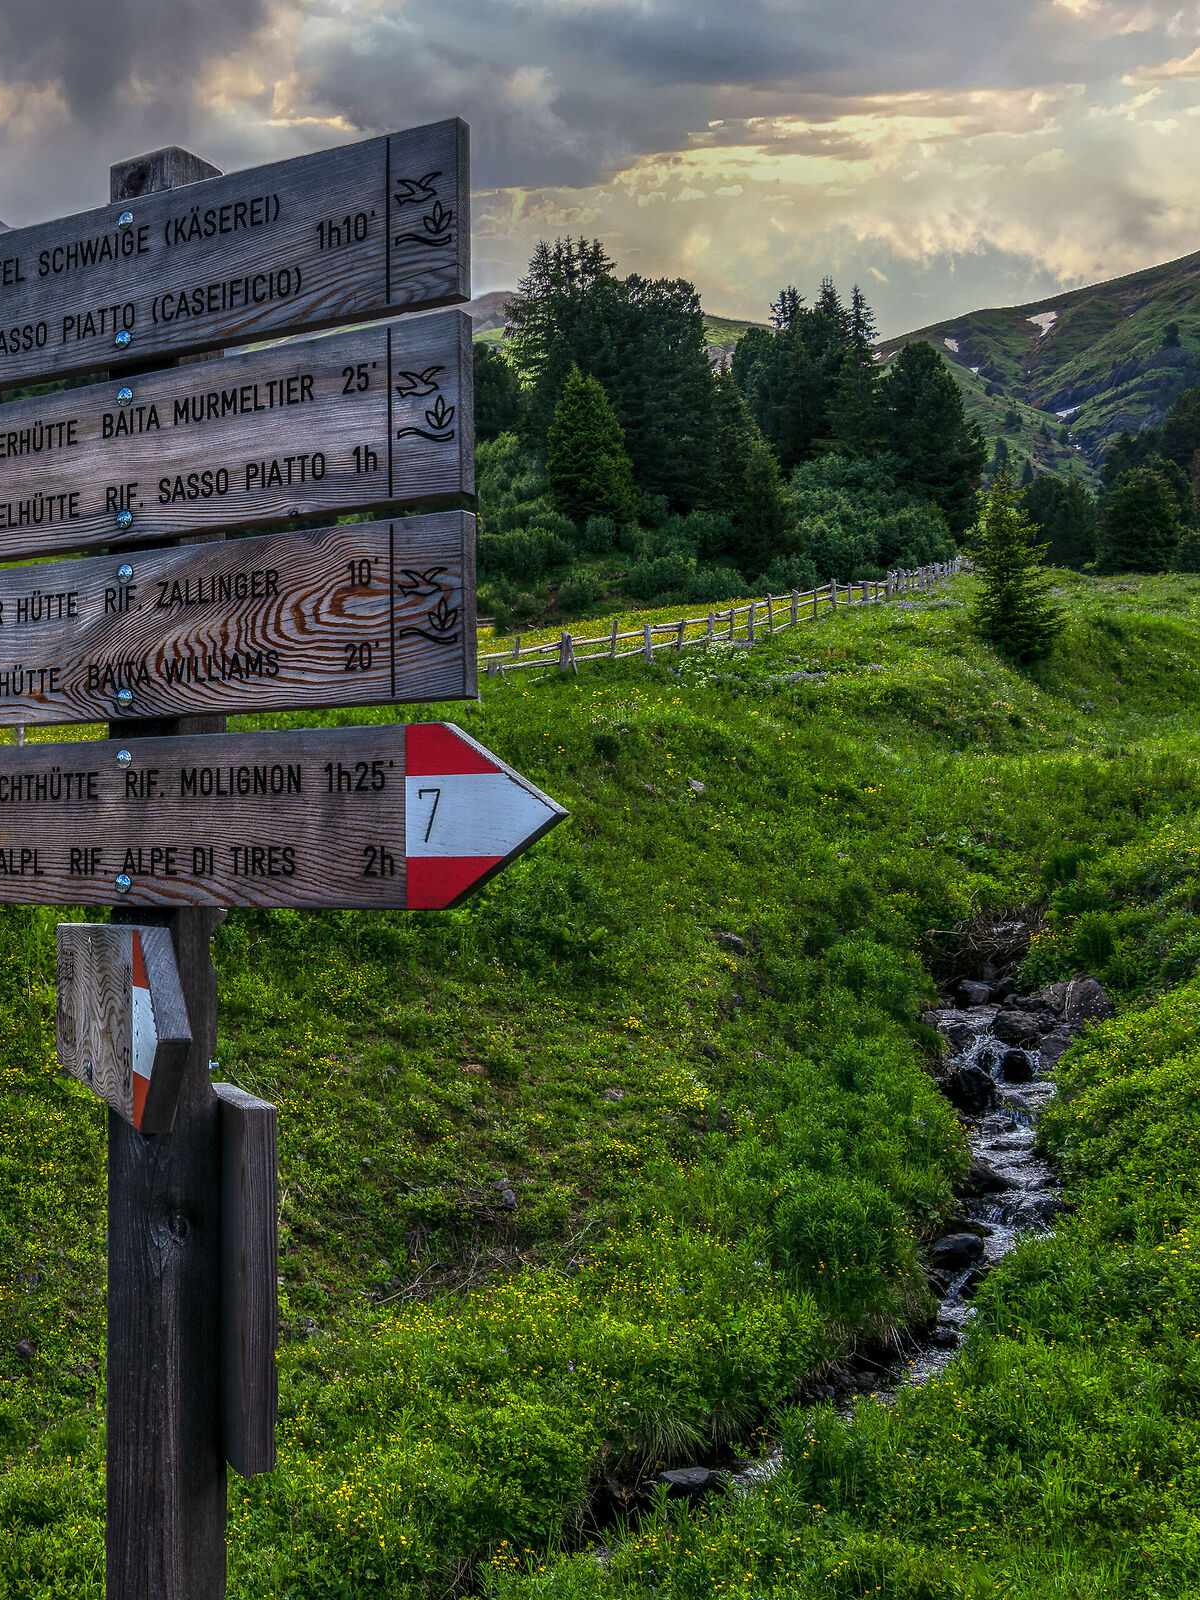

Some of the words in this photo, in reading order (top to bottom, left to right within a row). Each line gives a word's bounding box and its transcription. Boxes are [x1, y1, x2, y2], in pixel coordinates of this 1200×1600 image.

[38, 225, 150, 276] SCHWAIGE
[164, 194, 281, 247] (KÄSEREI)
[62, 303, 135, 343] PIATTO
[152, 267, 301, 324] (CASEIFICIO)
[102, 404, 160, 439] BAITA
[173, 374, 314, 426] MURMELTIER
[105, 483, 143, 513] RIF.
[158, 468, 229, 504] SASSO
[246, 453, 325, 491] PIATTO
[352, 445, 378, 474] 1h
[17, 590, 78, 623] HÜTTE
[104, 585, 142, 614] RIF.
[157, 569, 280, 609] ZALLINGER
[88, 661, 150, 691] BAITA
[164, 650, 280, 685] WILLIAMS
[125, 769, 165, 799] RIF.
[180, 763, 301, 797] MOLIGNON
[418, 788, 440, 843] 7
[70, 848, 108, 876] RIF.
[123, 847, 178, 876] ALPE
[192, 847, 214, 876] DI
[230, 846, 296, 876] TIRES
[363, 846, 395, 877] 2h
